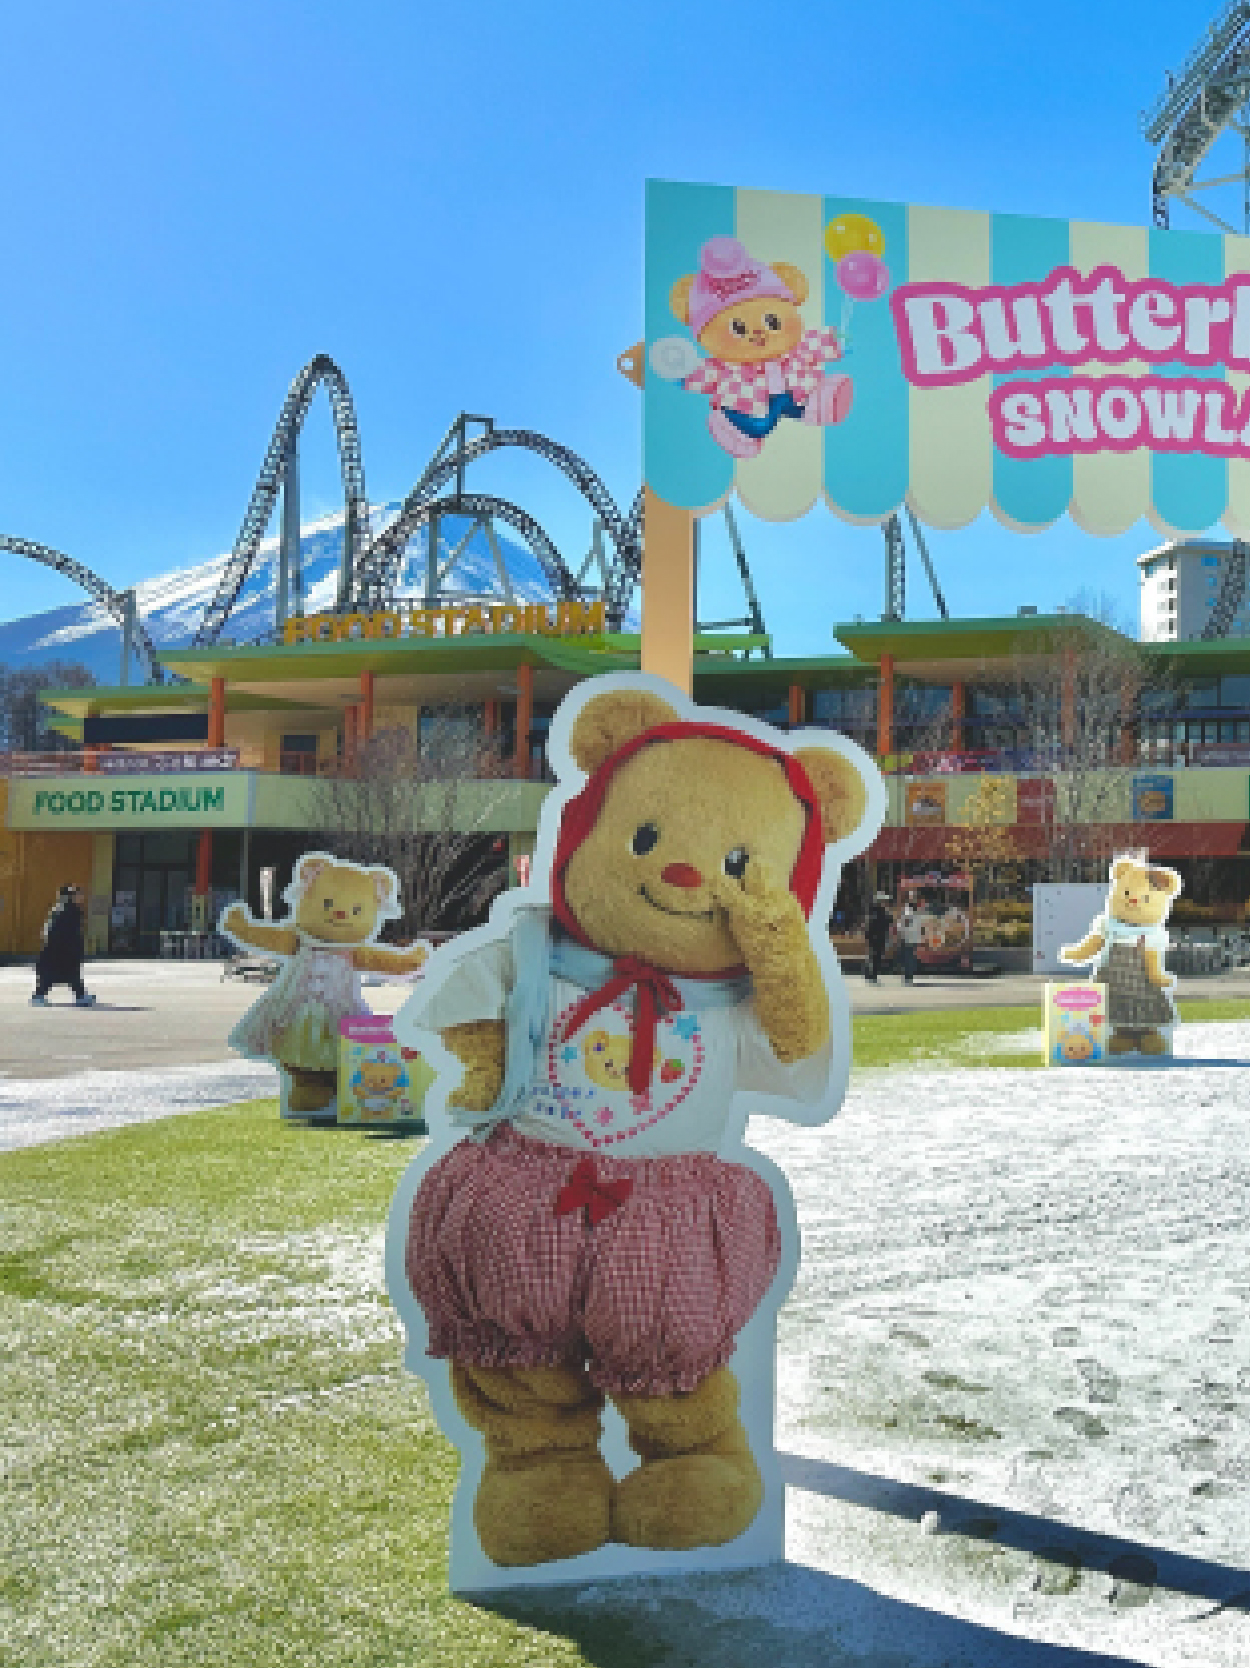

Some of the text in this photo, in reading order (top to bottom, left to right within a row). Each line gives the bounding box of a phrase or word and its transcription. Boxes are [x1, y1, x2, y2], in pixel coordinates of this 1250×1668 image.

[283, 602, 606, 645] FOOD STADIUM
[32, 787, 225, 815] FOOD STADIUM
